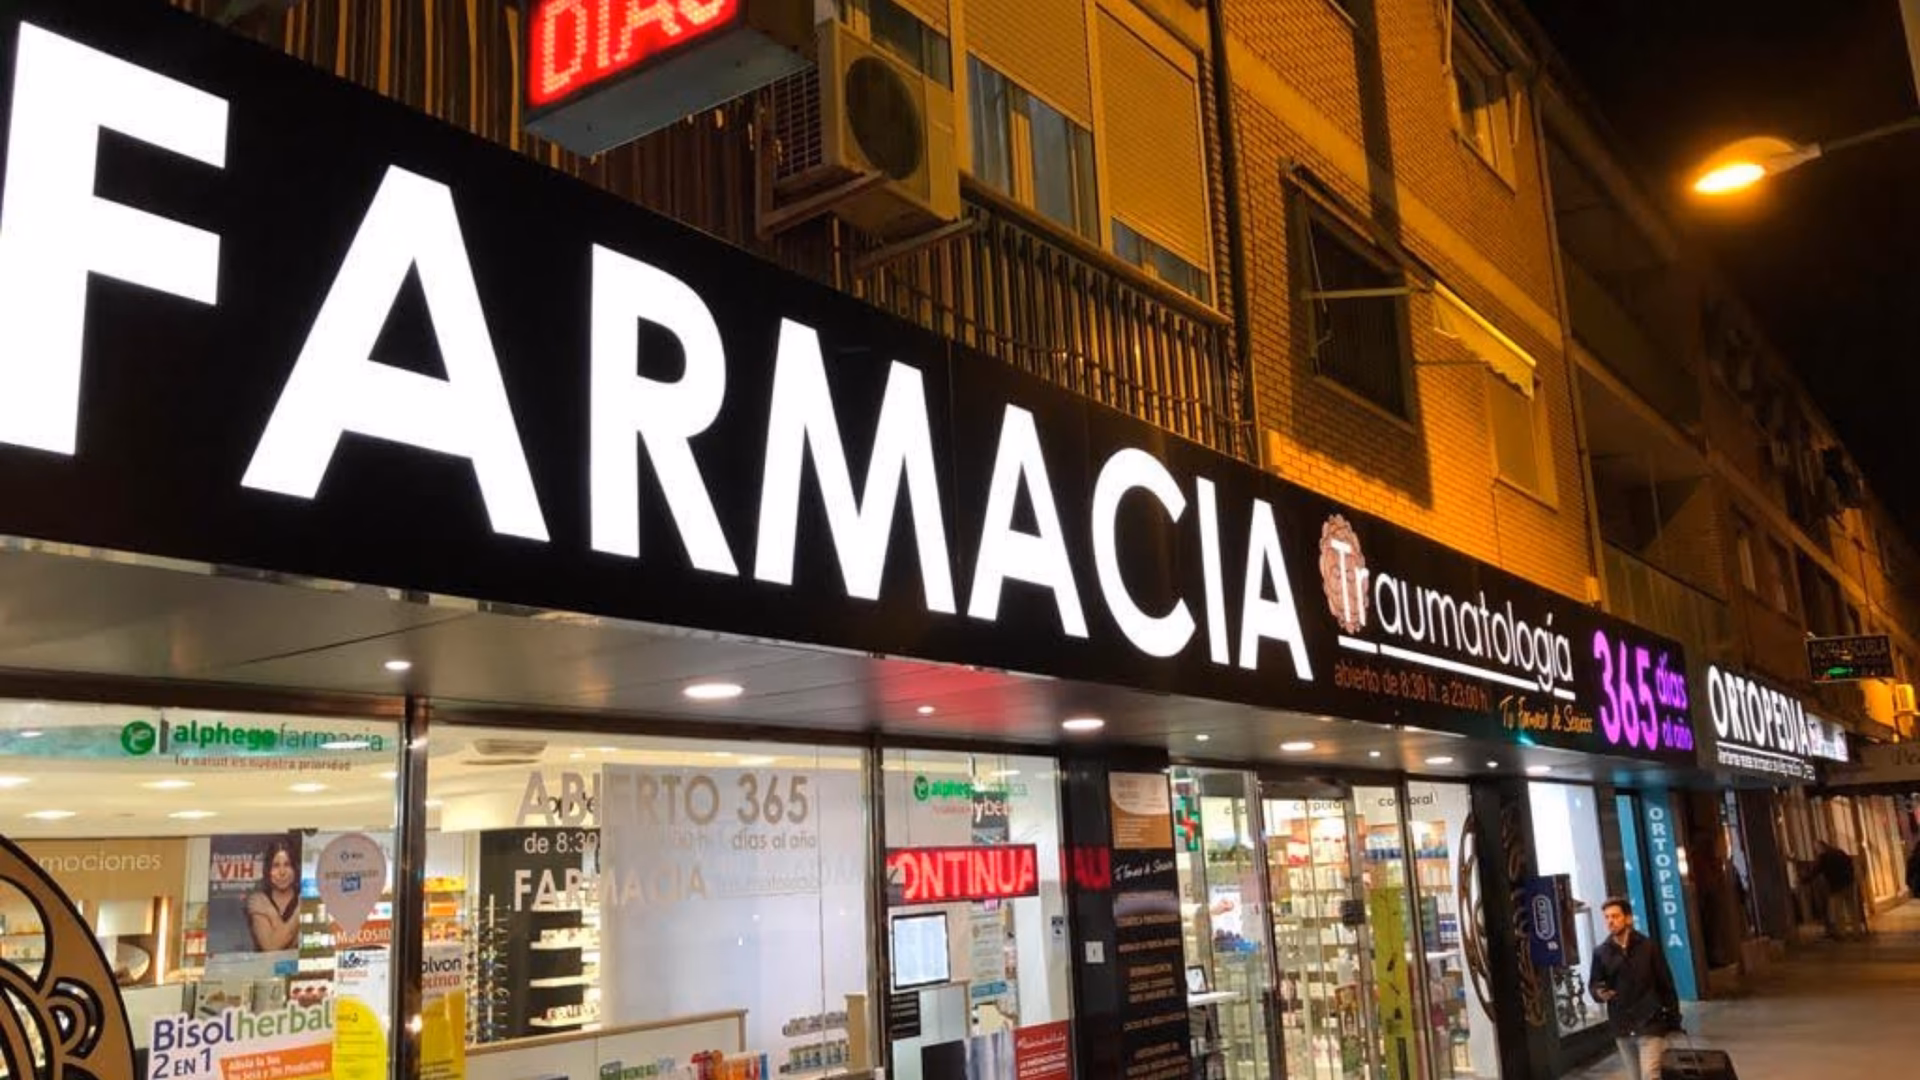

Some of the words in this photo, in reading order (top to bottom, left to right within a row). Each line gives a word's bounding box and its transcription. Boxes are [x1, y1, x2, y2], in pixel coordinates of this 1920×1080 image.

[540, 0, 729, 95] DIA
[0, 20, 1313, 682] FARMACIA
[1593, 629, 1659, 751] 365
[1708, 664, 1812, 757] ORTOPEDIA
[515, 770, 721, 828] ABIERTO
[736, 772, 809, 826] 365
[218, 862, 255, 879] VIH
[524, 831, 550, 854] de
[1649, 807, 1683, 947] ORTOPEDIA
[514, 866, 706, 913] FARMACIA
[152, 1052, 169, 1079] 2
[174, 1056, 196, 1076] EN
[200, 1047, 212, 1072] 1
